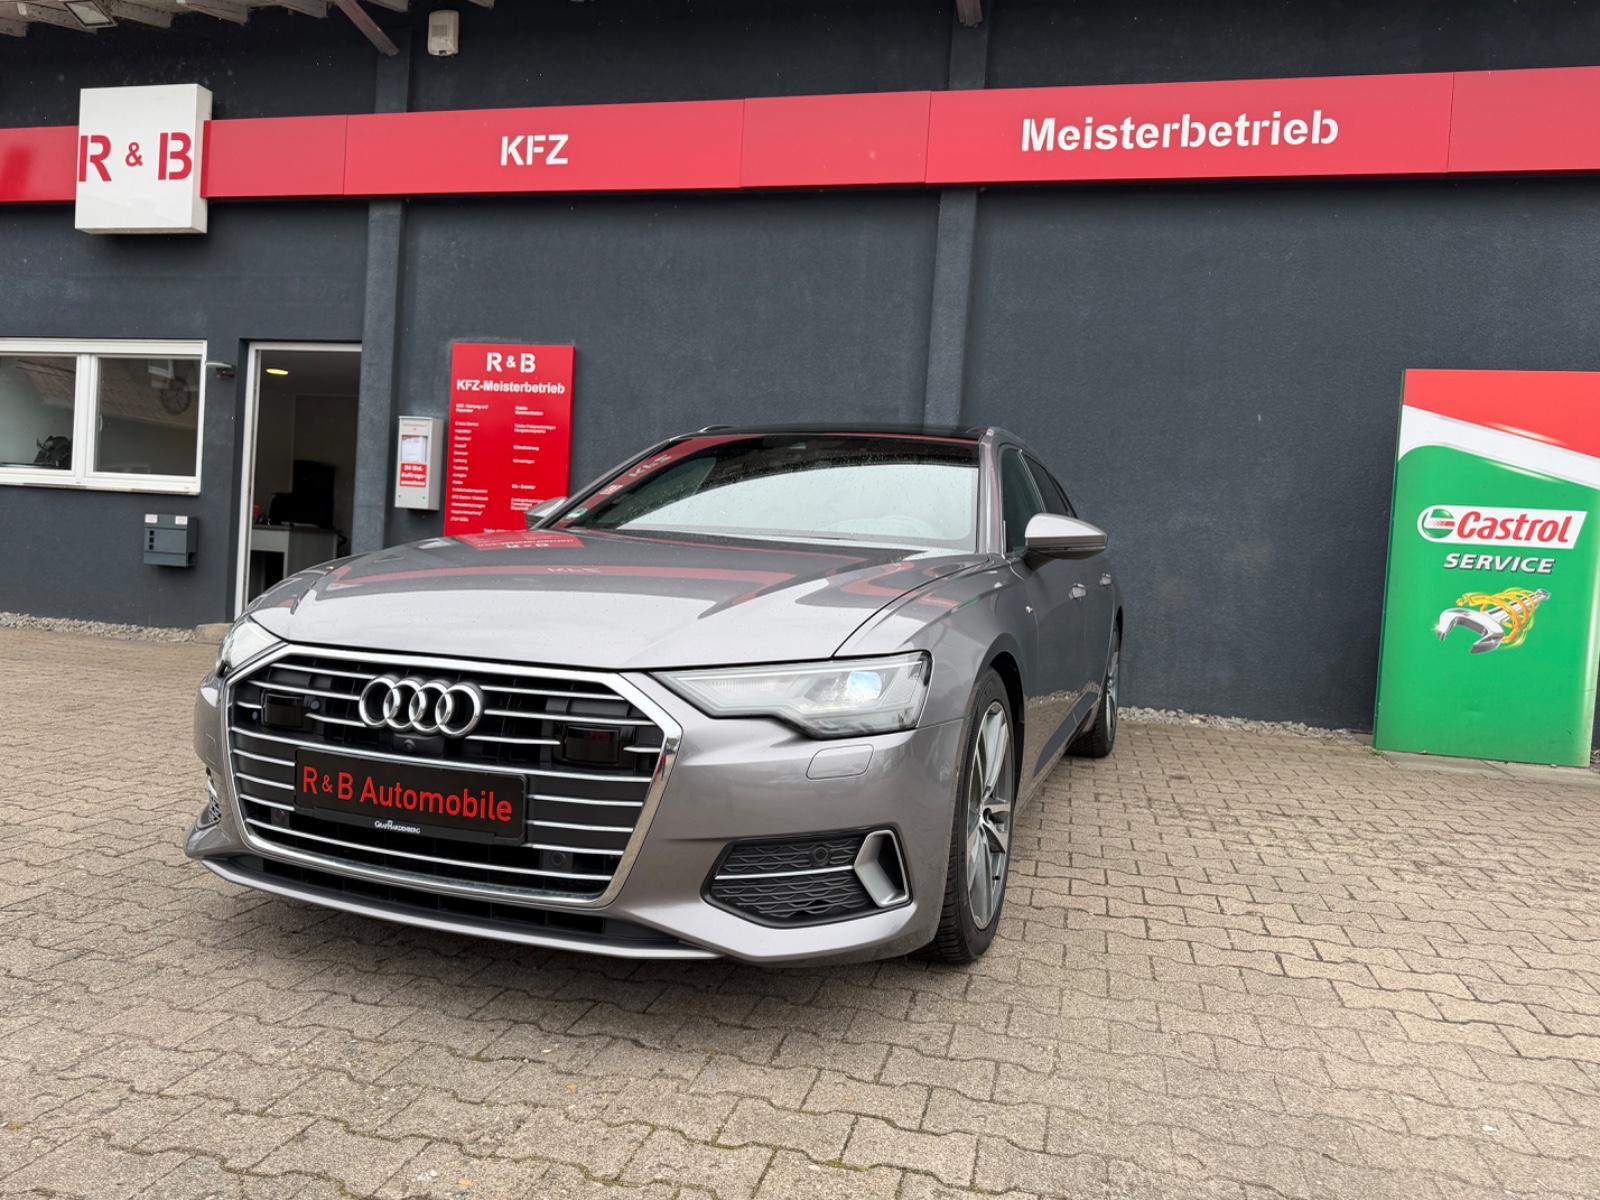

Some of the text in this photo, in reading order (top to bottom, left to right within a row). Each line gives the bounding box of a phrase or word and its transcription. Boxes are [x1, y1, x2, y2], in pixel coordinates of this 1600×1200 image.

[500, 109, 1339, 166] KFZ Meisterbetrieb
[79, 132, 192, 182] R & B
[486, 352, 536, 373] R & B
[456, 379, 565, 394] KFZ-Meisterbetrieb
[1457, 511, 1573, 543] Castrol
[1443, 553, 1555, 574] SERVICE
[303, 766, 513, 822] R & B Automobile
